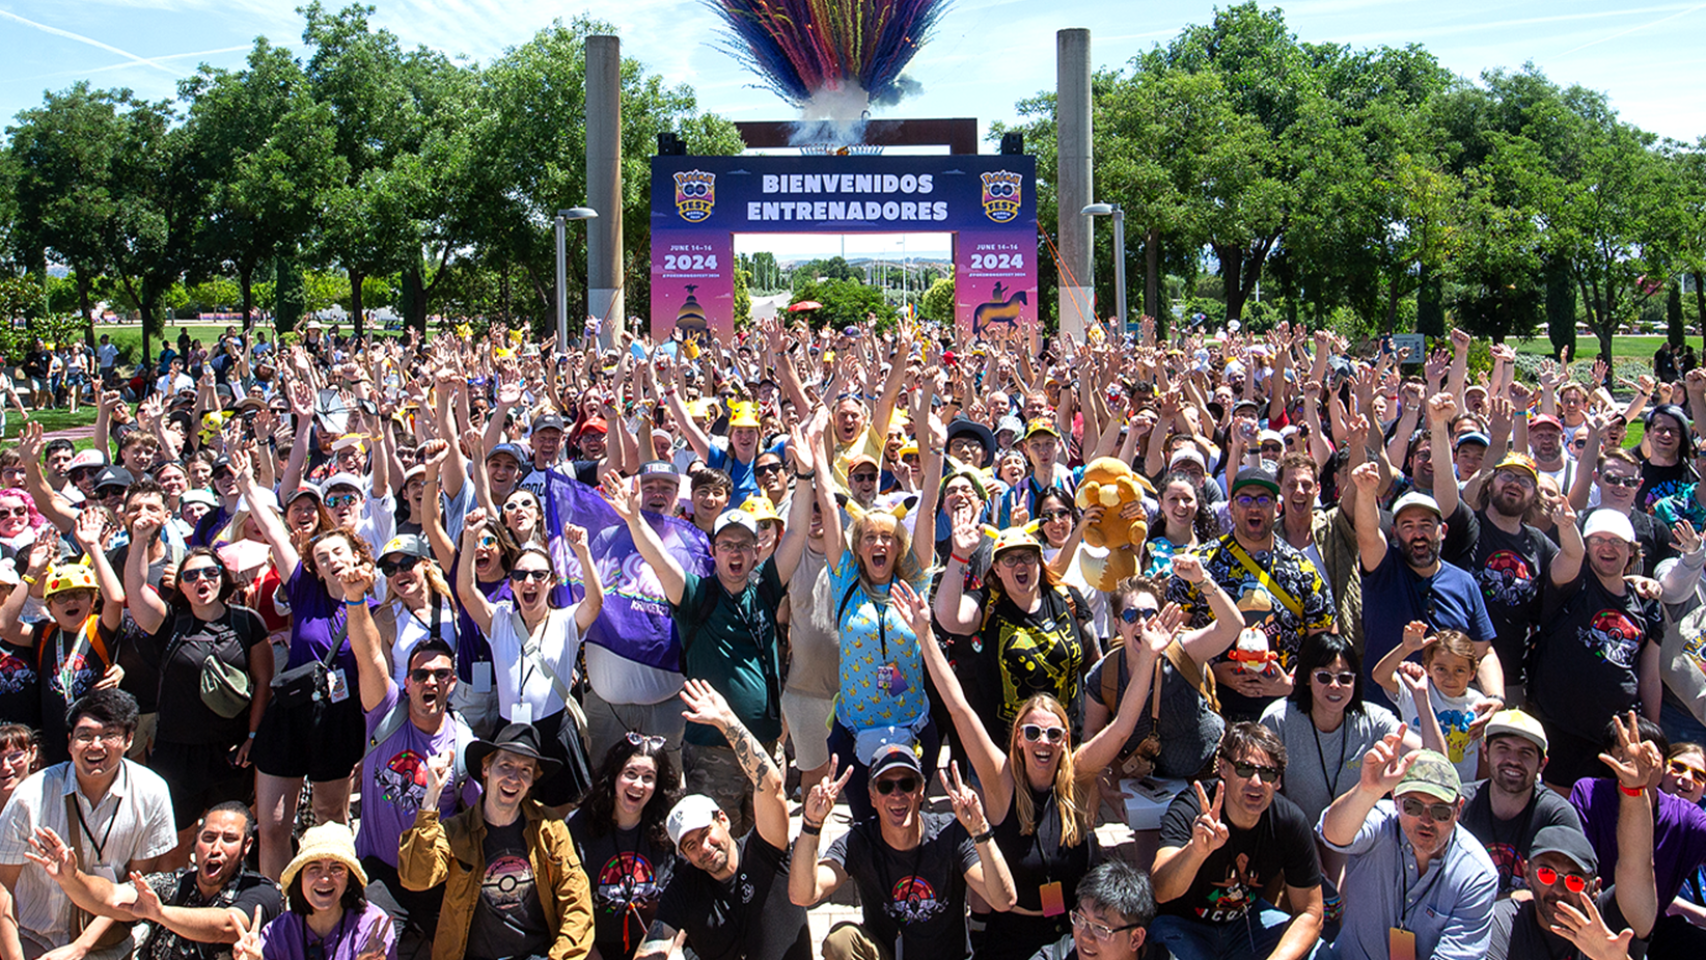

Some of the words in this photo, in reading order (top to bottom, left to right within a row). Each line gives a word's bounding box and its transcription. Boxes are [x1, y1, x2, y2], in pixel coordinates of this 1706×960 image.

[683, 183, 708, 197] GO
[762, 174, 934, 194] BIENVENIDOS
[990, 184, 1014, 198] GO
[681, 201, 710, 211] FEST
[747, 201, 948, 221] ENTRENADORES
[988, 201, 1017, 211] FEST
[664, 254, 718, 270] 2024
[970, 253, 1024, 269] 2024
